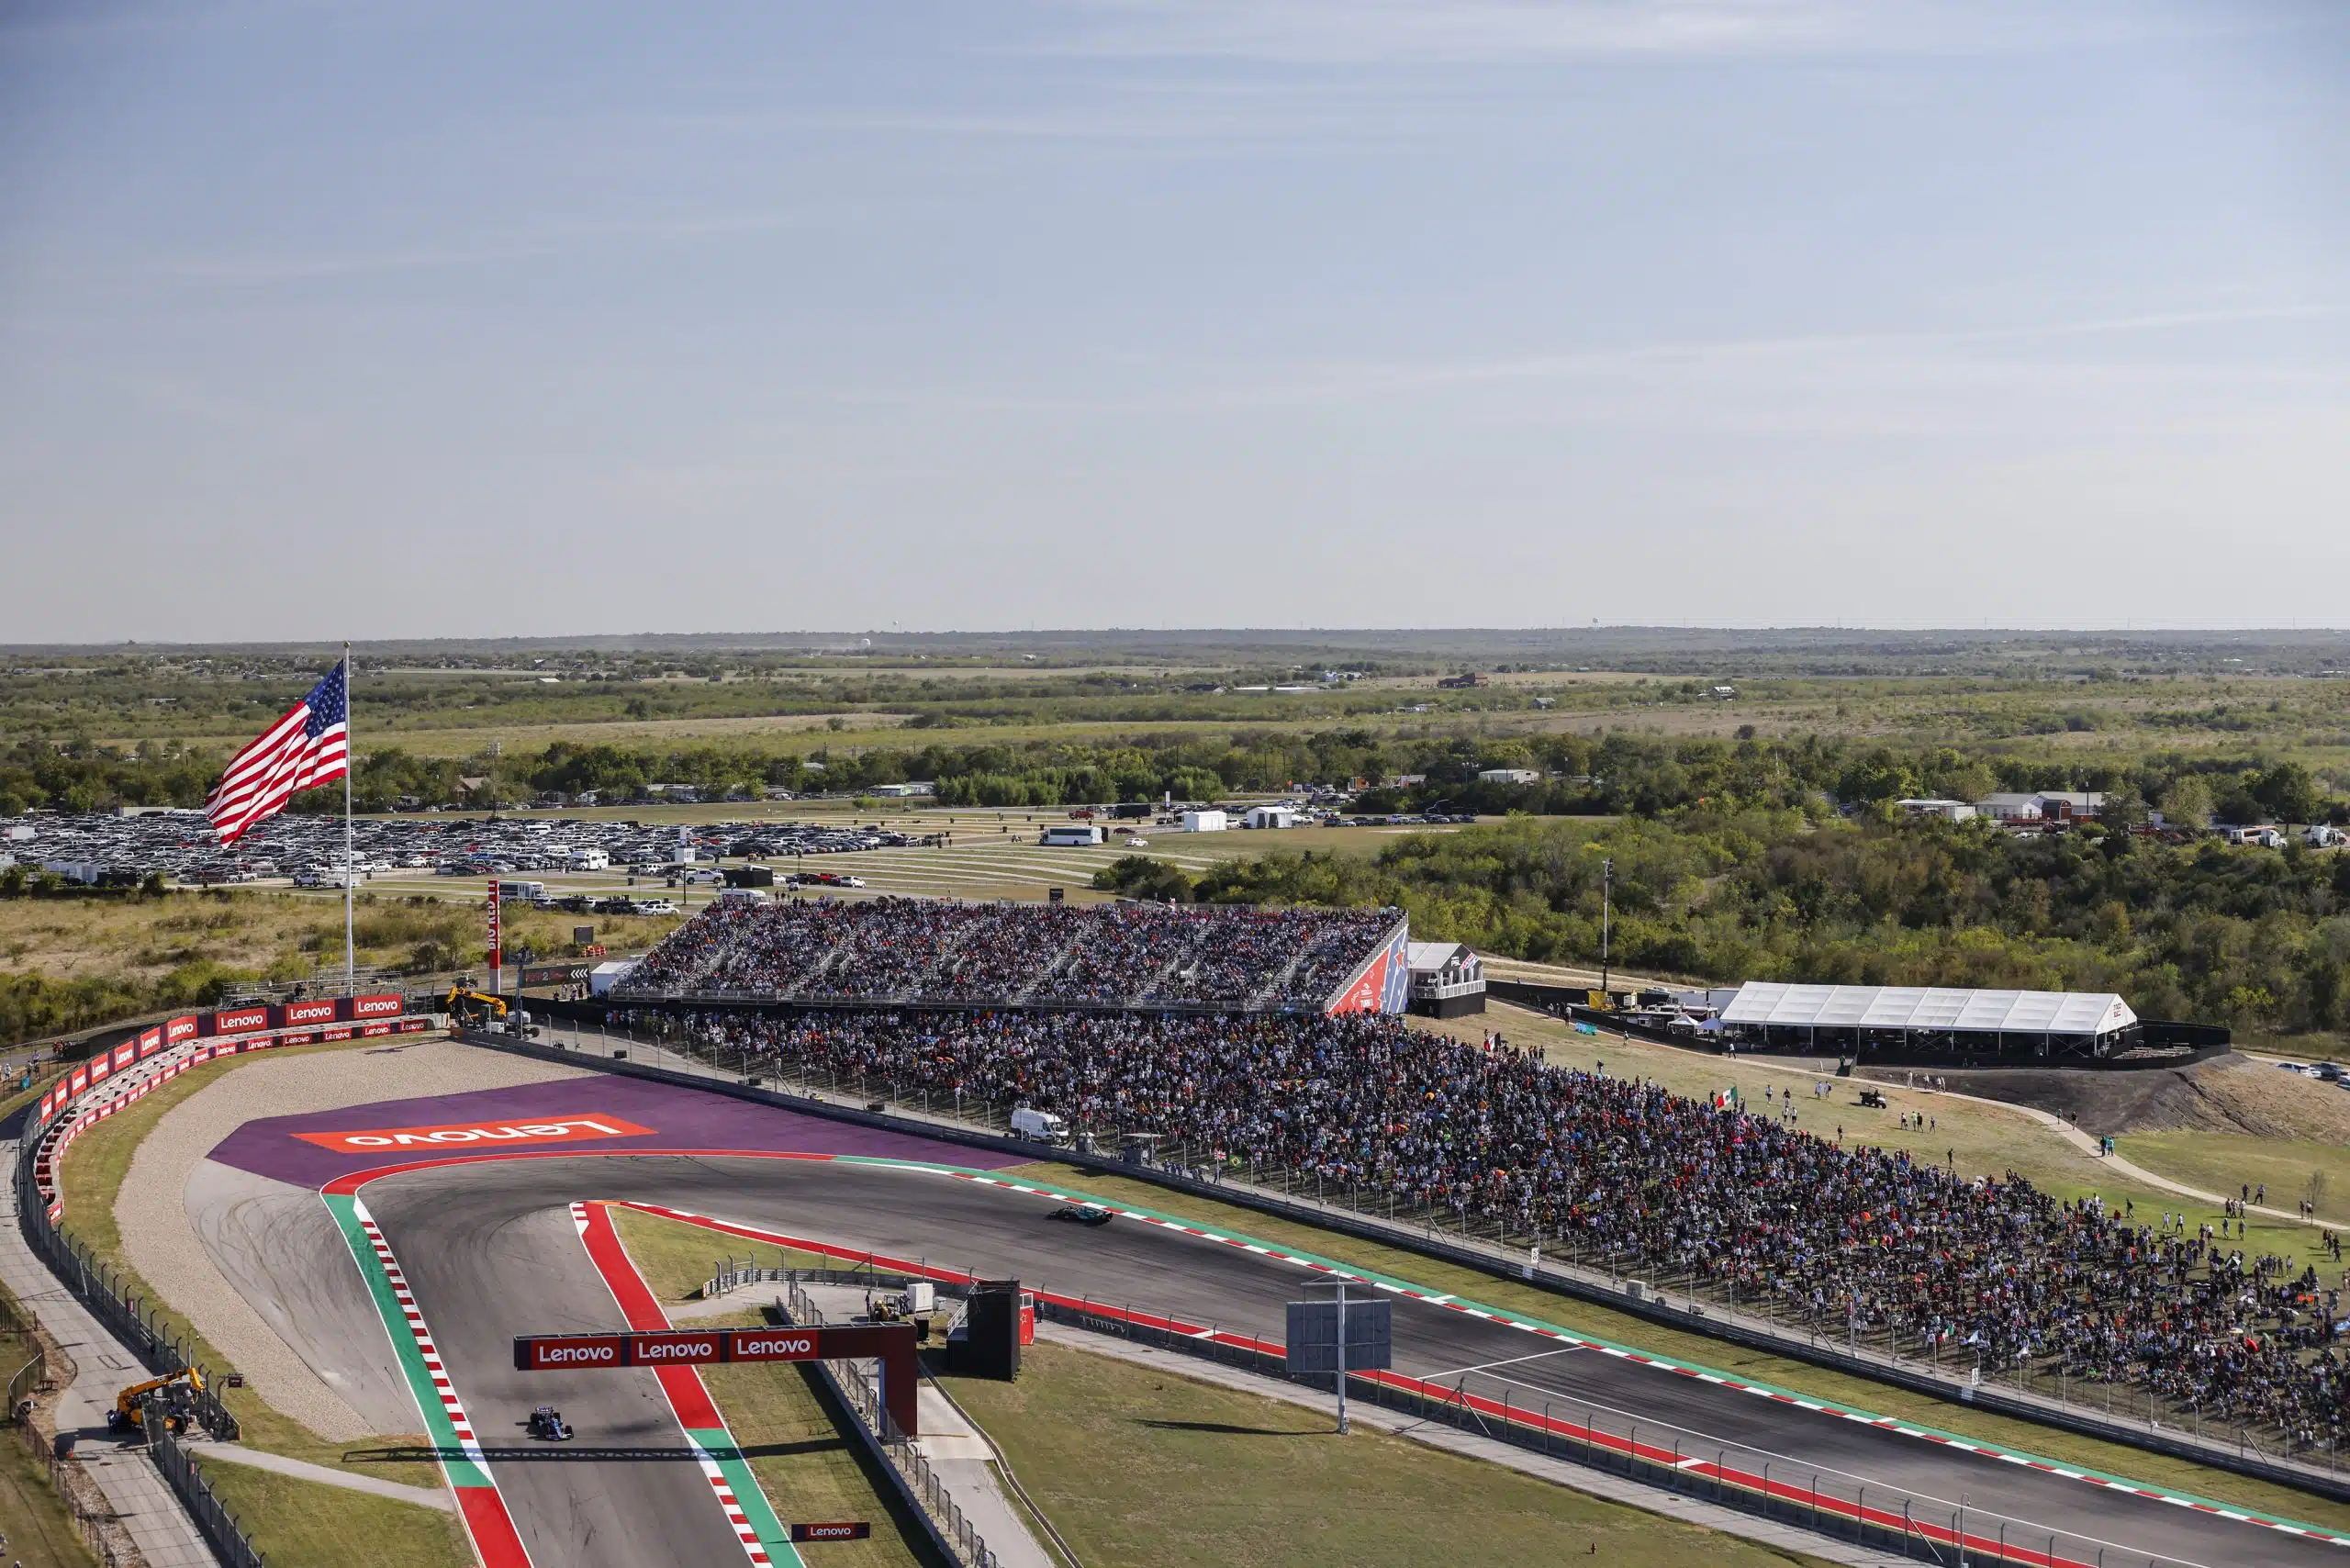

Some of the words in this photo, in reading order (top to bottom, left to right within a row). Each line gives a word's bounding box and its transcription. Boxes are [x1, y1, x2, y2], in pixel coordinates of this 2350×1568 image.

[290, 1006, 331, 1020] Lenovo
[358, 1001, 397, 1013] Lenovo
[221, 1014, 263, 1029] Lenovo
[401, 1022, 424, 1031] Lenovo
[169, 1023, 194, 1038] Lenovo
[325, 1030, 350, 1040] Lenovo
[365, 1025, 389, 1036] Lenovo
[248, 1039, 271, 1049] Lenovo
[285, 1035, 309, 1045] Lenovo
[216, 1045, 236, 1056] Lenovo
[344, 1120, 622, 1146] Lenovo
[638, 1341, 712, 1359] Lenovo
[737, 1338, 811, 1356] Lenovo
[539, 1345, 613, 1363] Lenovo
[810, 1527, 852, 1537] Lenovo
